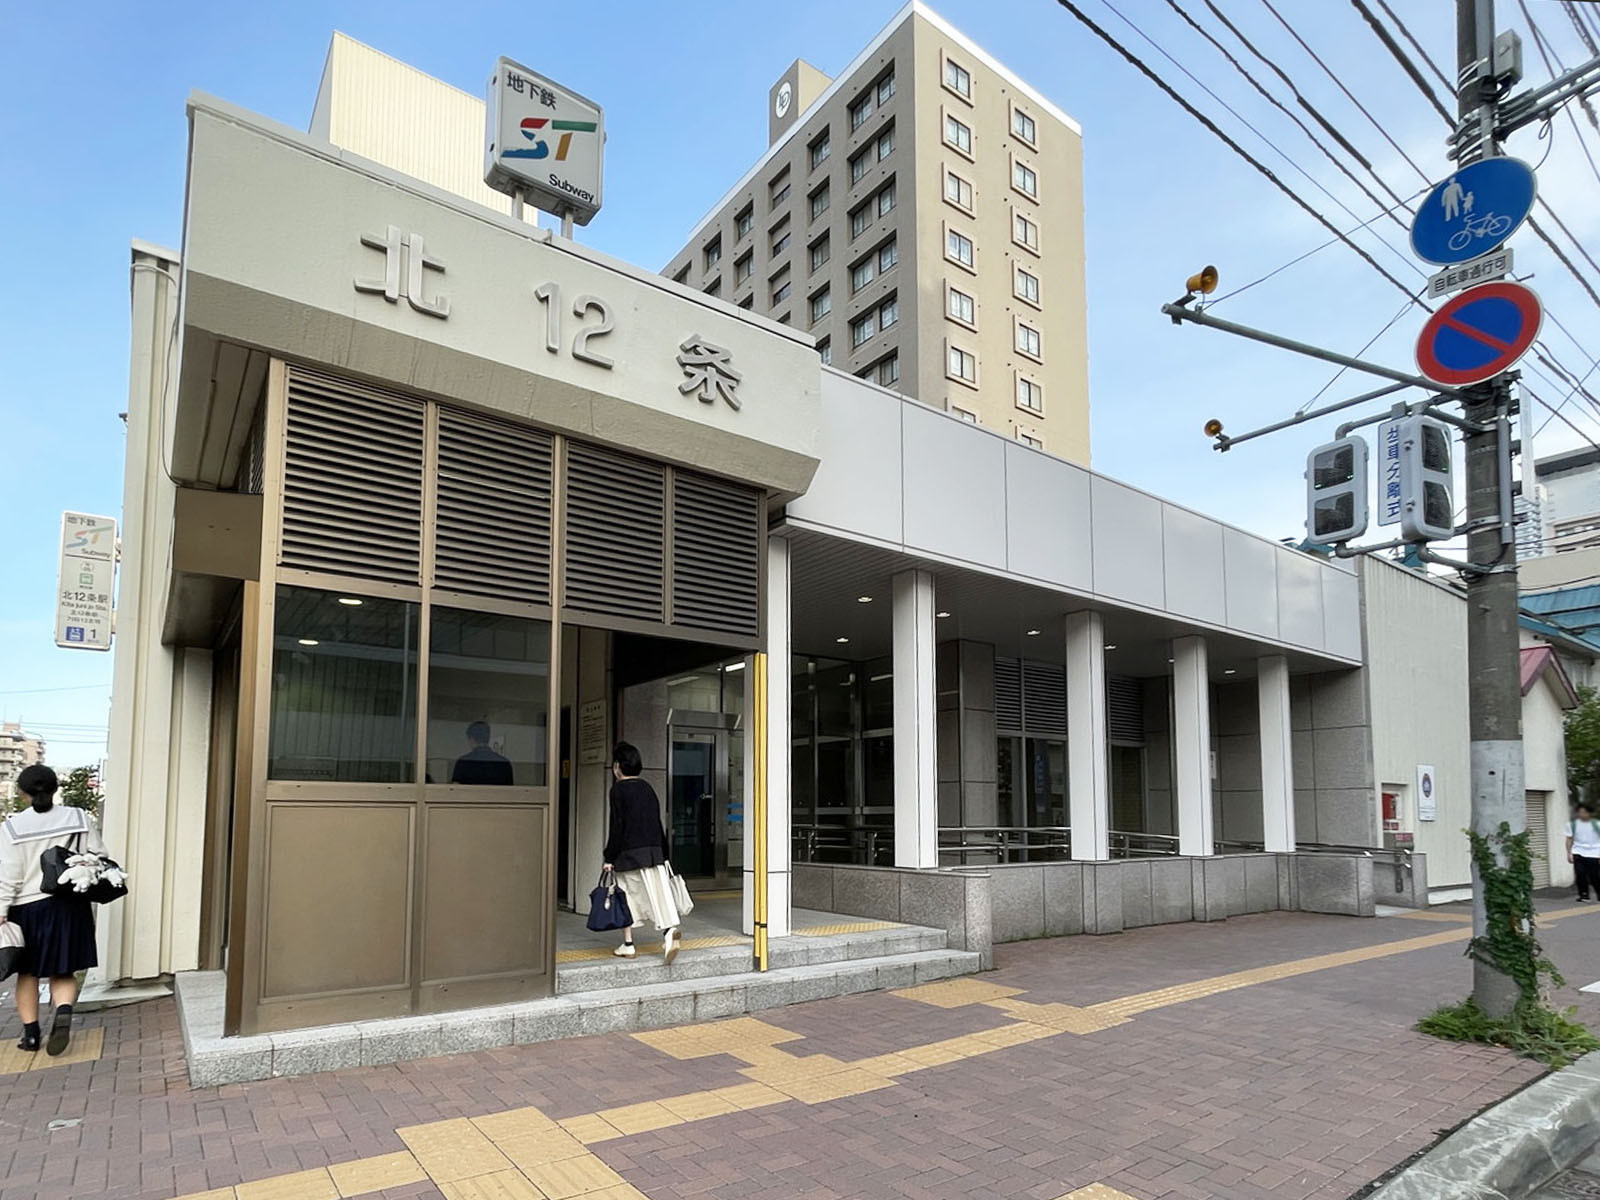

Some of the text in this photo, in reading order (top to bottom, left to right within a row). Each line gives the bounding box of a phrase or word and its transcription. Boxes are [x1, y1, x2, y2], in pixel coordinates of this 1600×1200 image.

[507, 71, 557, 110] 地下鉄
[549, 173, 595, 203] Subway
[1435, 255, 1506, 292] 自転車通行可
[354, 225, 743, 411] 北 12 条
[62, 591, 108, 604] 北12条駅
[90, 629, 96, 639] 1
